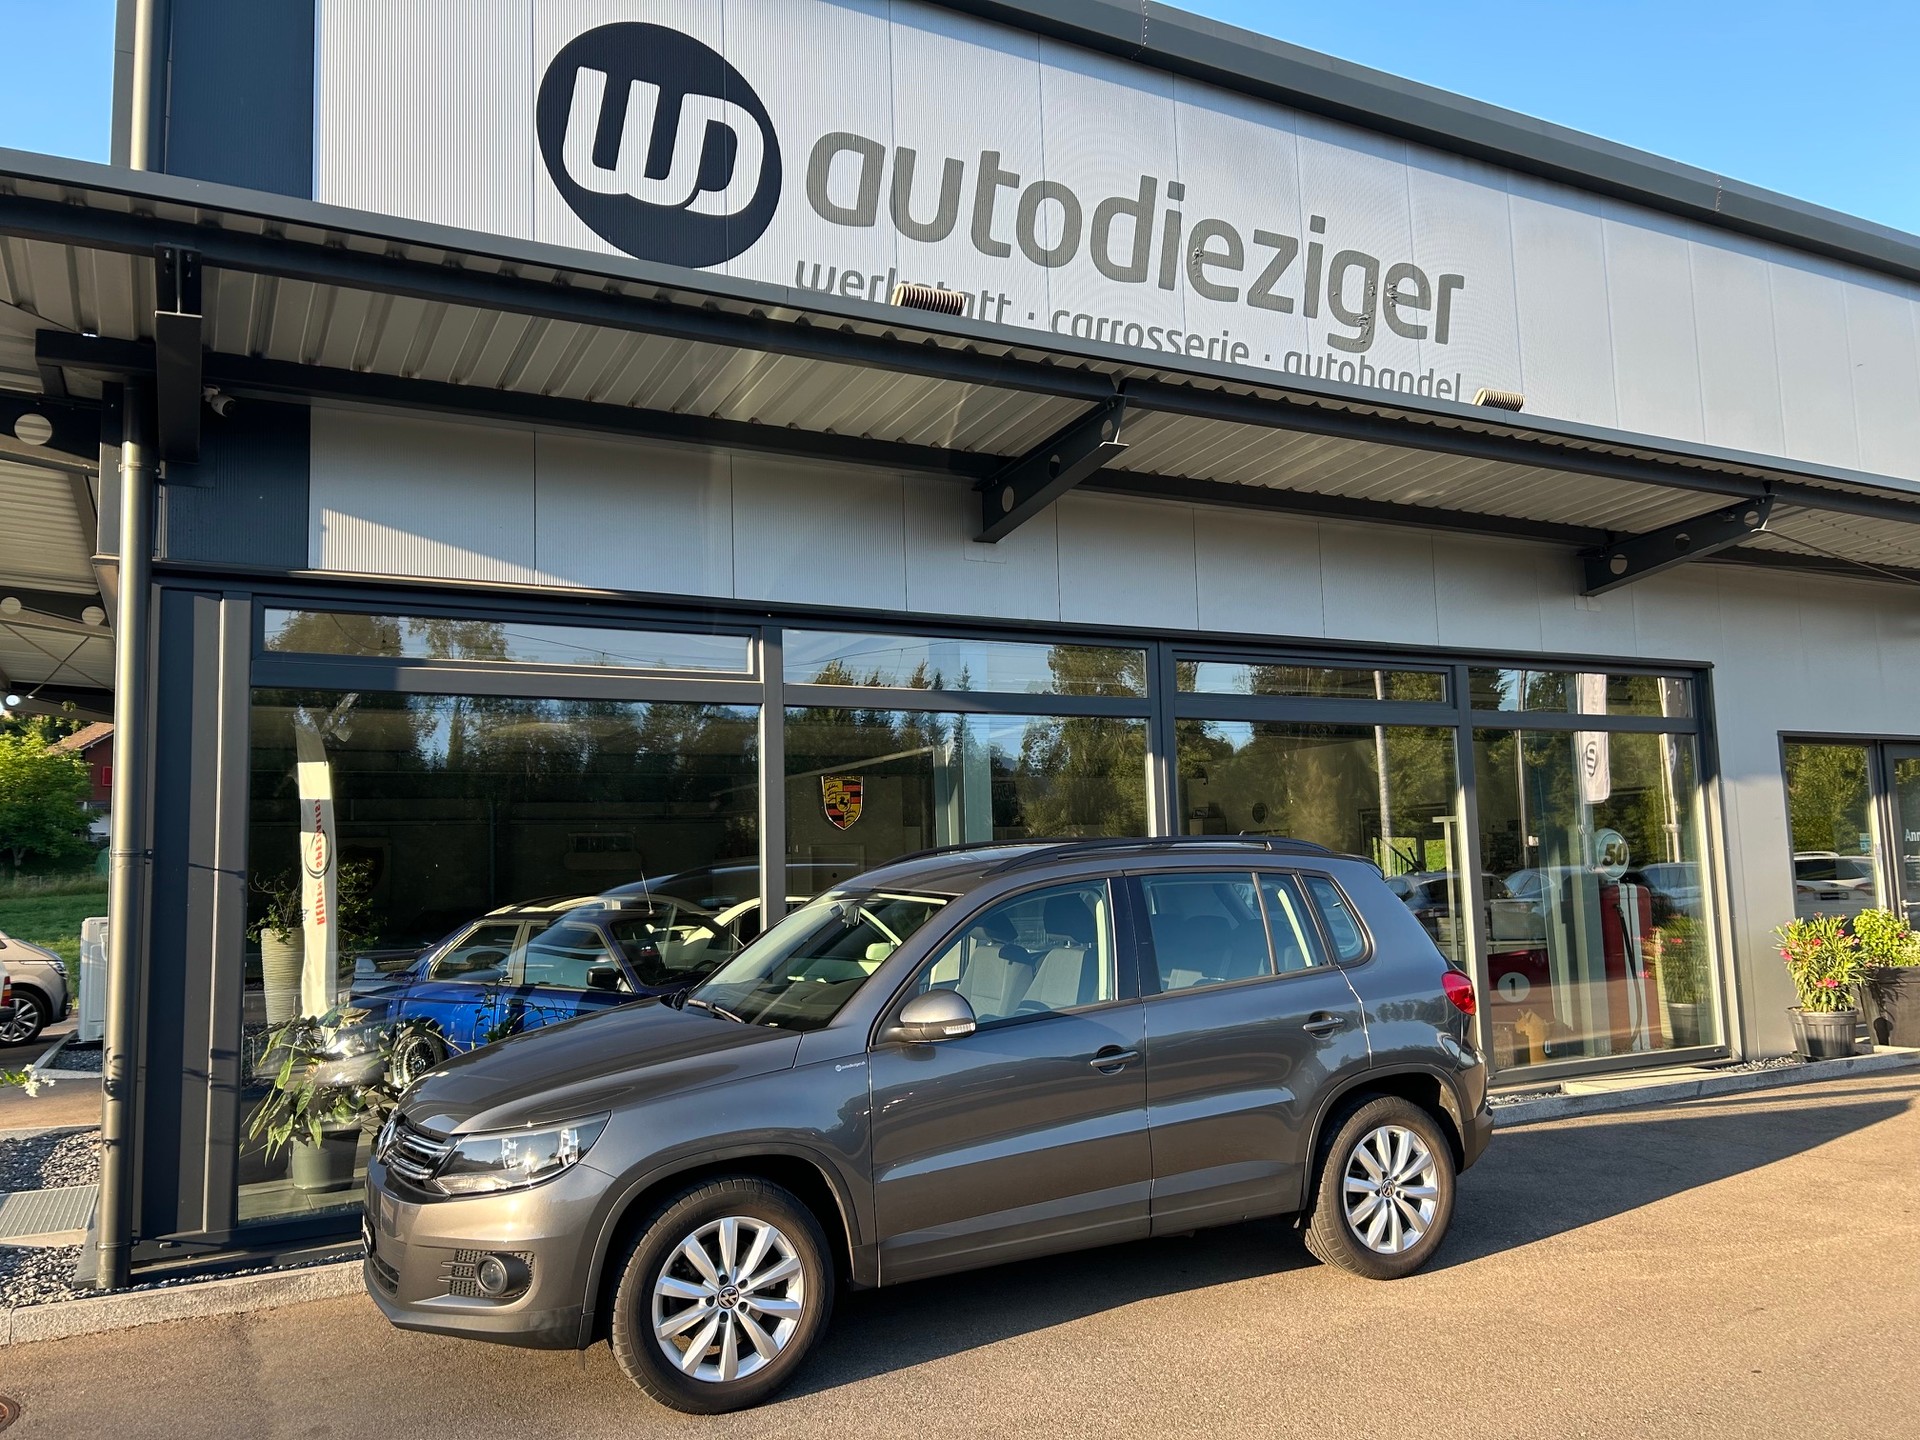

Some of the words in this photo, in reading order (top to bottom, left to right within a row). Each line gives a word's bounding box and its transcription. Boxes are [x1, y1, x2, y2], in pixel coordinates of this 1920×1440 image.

[806, 131, 1465, 354] autodiezger
[795, 260, 1012, 323] weratt
[1051, 309, 1250, 365] carrosserie
[1284, 350, 1461, 402] autohandel
[1602, 843, 1627, 866] 50
[1509, 977, 1517, 997] 1
